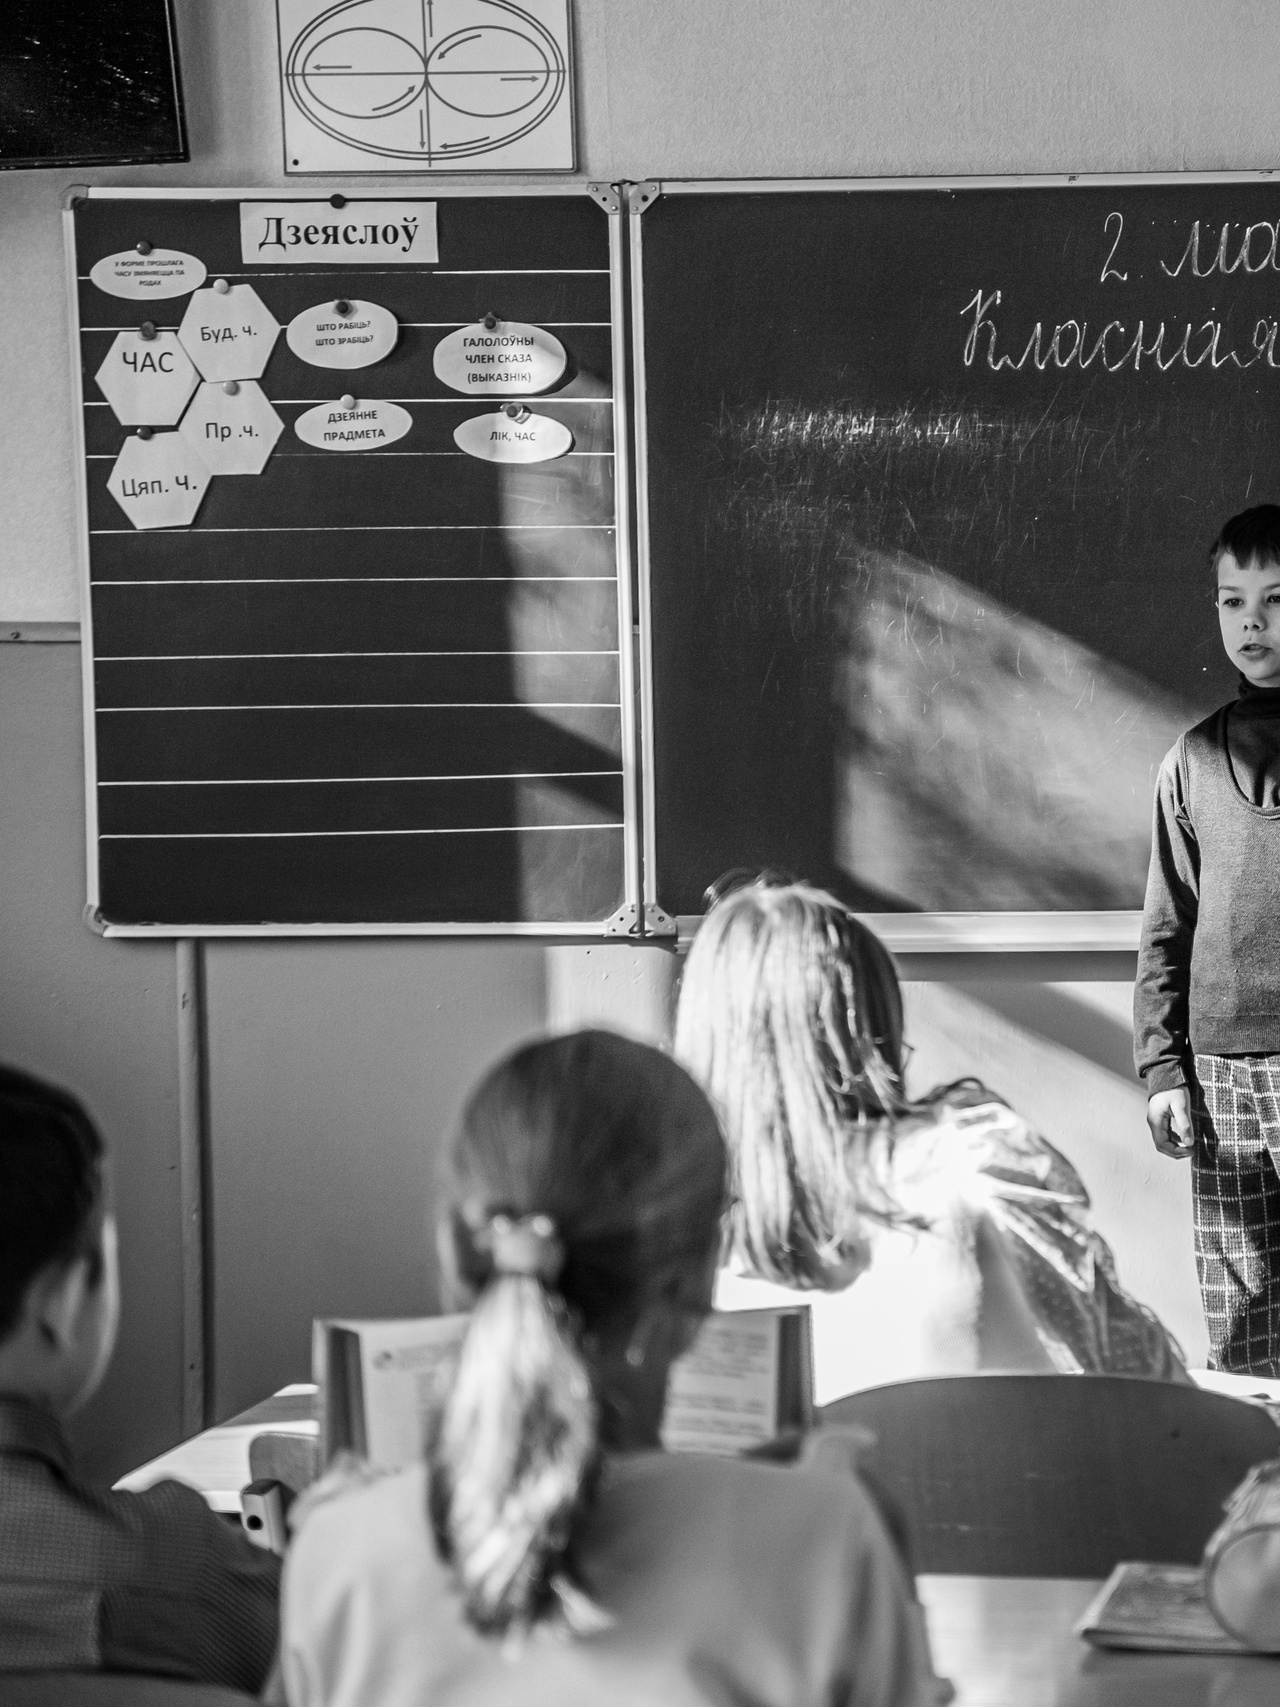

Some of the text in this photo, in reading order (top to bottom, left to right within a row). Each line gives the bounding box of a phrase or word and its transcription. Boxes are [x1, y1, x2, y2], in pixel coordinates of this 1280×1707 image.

[258, 216, 419, 253] Дзеяслоў
[1100, 211, 1128, 282] 2
[316, 320, 371, 332] ШТО РАБІЦЬ?
[200, 326, 238, 344] Буд.
[315, 335, 374, 346] ШТО ЗРАБІЦЬ?
[463, 335, 534, 347] ГАЛОЛОЎНЫ
[122, 351, 174, 373] ЧАС
[465, 353, 533, 364] ЧЛЕН СКАЗА
[467, 372, 532, 384] (ВЫКАЗНІК)
[327, 410, 378, 424] ДЗЕЯННЕ
[205, 422, 232, 442] Пр
[323, 429, 386, 442] ПРАДМЕТА
[490, 431, 536, 442] ЛІК, ЧАС
[121, 478, 169, 498] Цяп.
